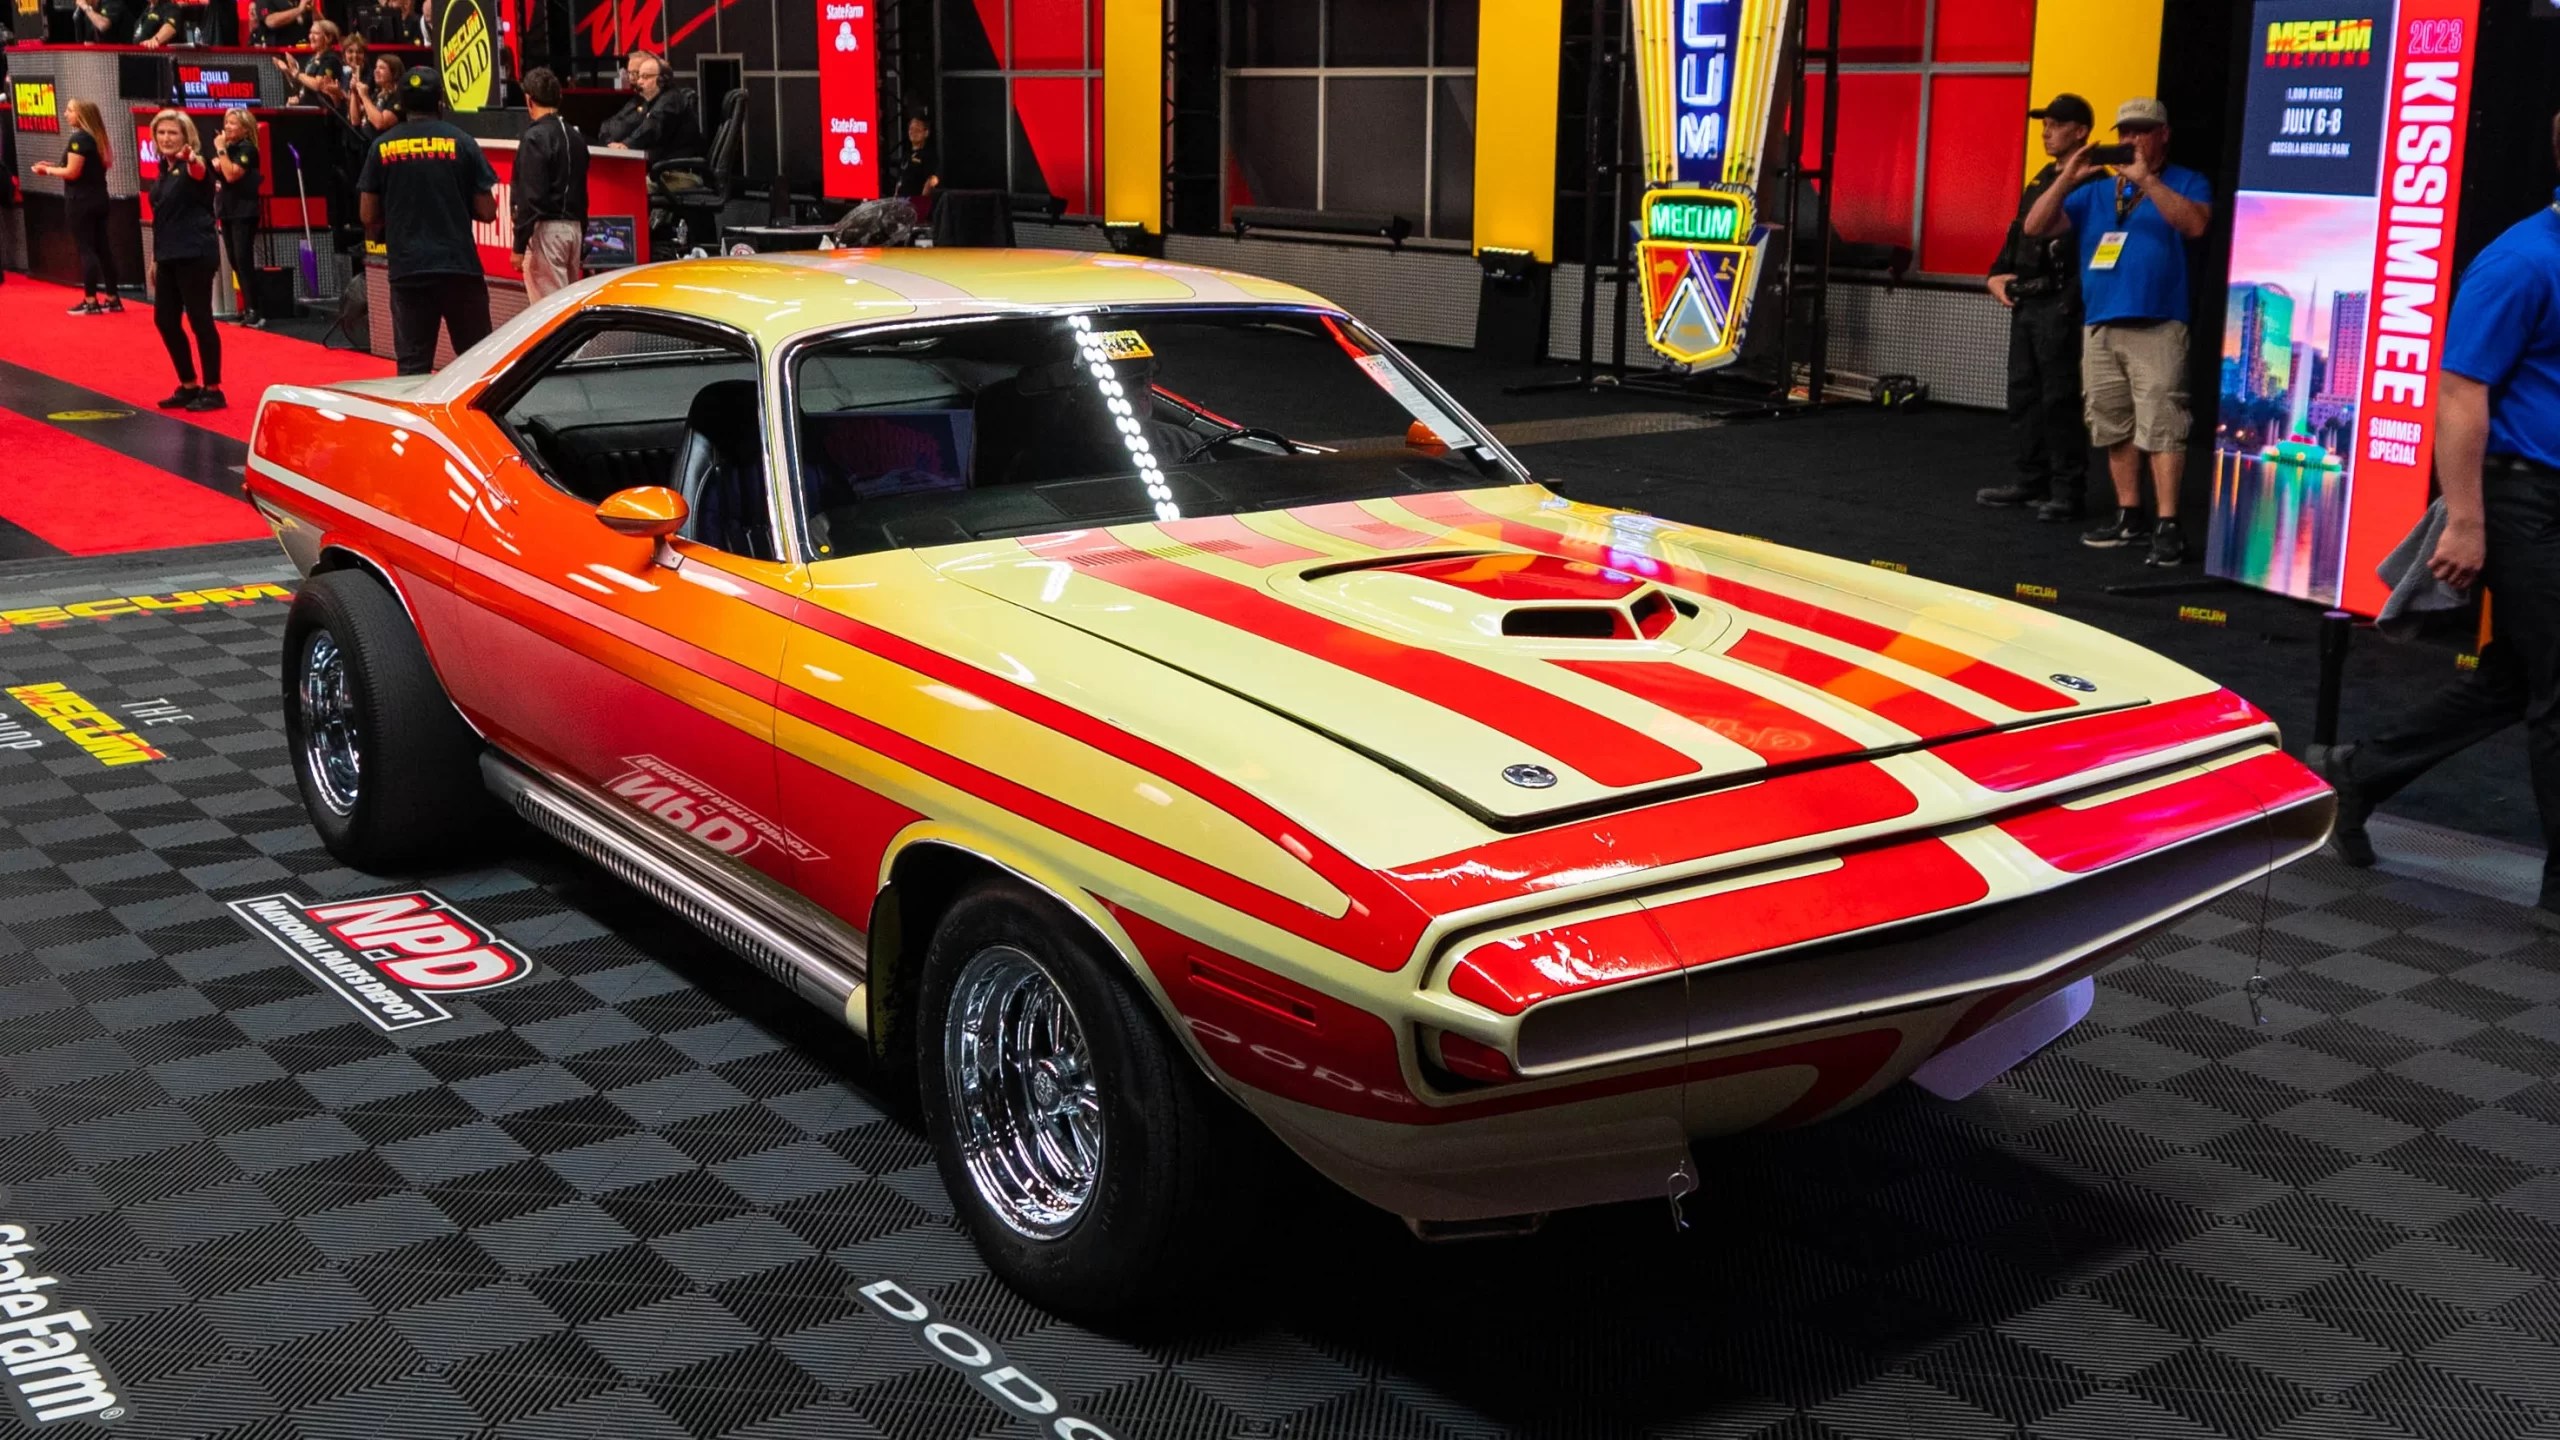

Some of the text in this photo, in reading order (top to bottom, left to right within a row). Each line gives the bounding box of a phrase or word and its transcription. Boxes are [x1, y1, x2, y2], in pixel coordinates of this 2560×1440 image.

[443, 8, 481, 66] MECUM
[2266, 18, 2373, 53] MECUM
[2408, 19, 2463, 54] 2023
[448, 38, 489, 104] SOLD
[2264, 51, 2371, 67] AUCTIONS
[184, 82, 208, 95] BEEN
[200, 71, 229, 83] COULD
[15, 83, 57, 116] MECUM
[2308, 87, 2343, 101] VEHICLES
[2280, 107, 2342, 136] JULY 6-8
[379, 137, 456, 158] MECUM
[381, 151, 457, 165] AUCTIONS
[1650, 203, 1735, 239] MECUM
[2371, 61, 2460, 407] KISSIMMEE
[2369, 416, 2422, 444] SUMMER
[2369, 438, 2417, 466] SPECIAL
[0, 583, 291, 626] ECUM
[2016, 583, 2058, 599] MECUM
[2180, 605, 2227, 623] MECUM
[5, 682, 167, 766] MECUM
[121, 698, 194, 725] THE
[308, 896, 514, 988] NPD
[247, 900, 425, 1020] NATIONAL PARTS DEPOT
